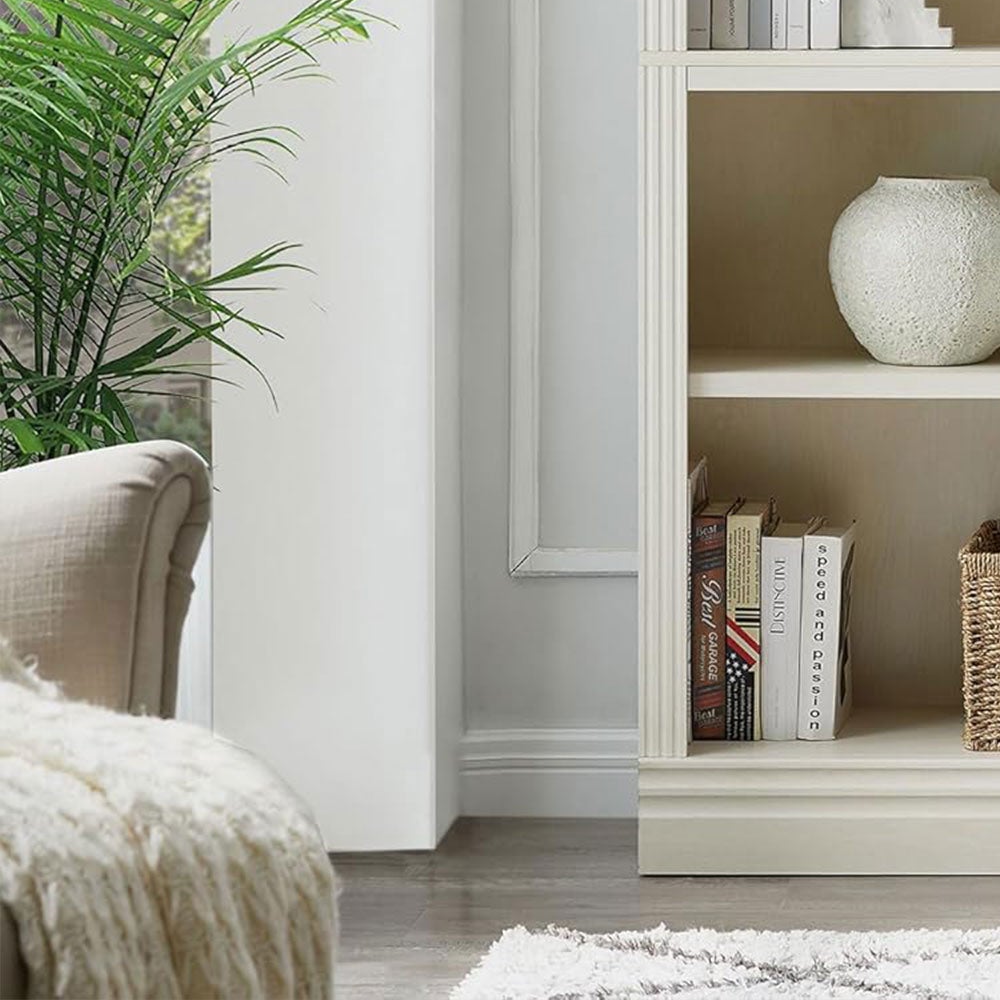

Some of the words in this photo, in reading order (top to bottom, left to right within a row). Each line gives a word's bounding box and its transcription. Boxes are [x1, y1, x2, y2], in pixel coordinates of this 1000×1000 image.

[815, 544, 829, 601] speed
[700, 574, 722, 629] Best
[813, 609, 825, 642] and
[707, 631, 719, 681] GARAGE
[809, 650, 824, 730] passion
